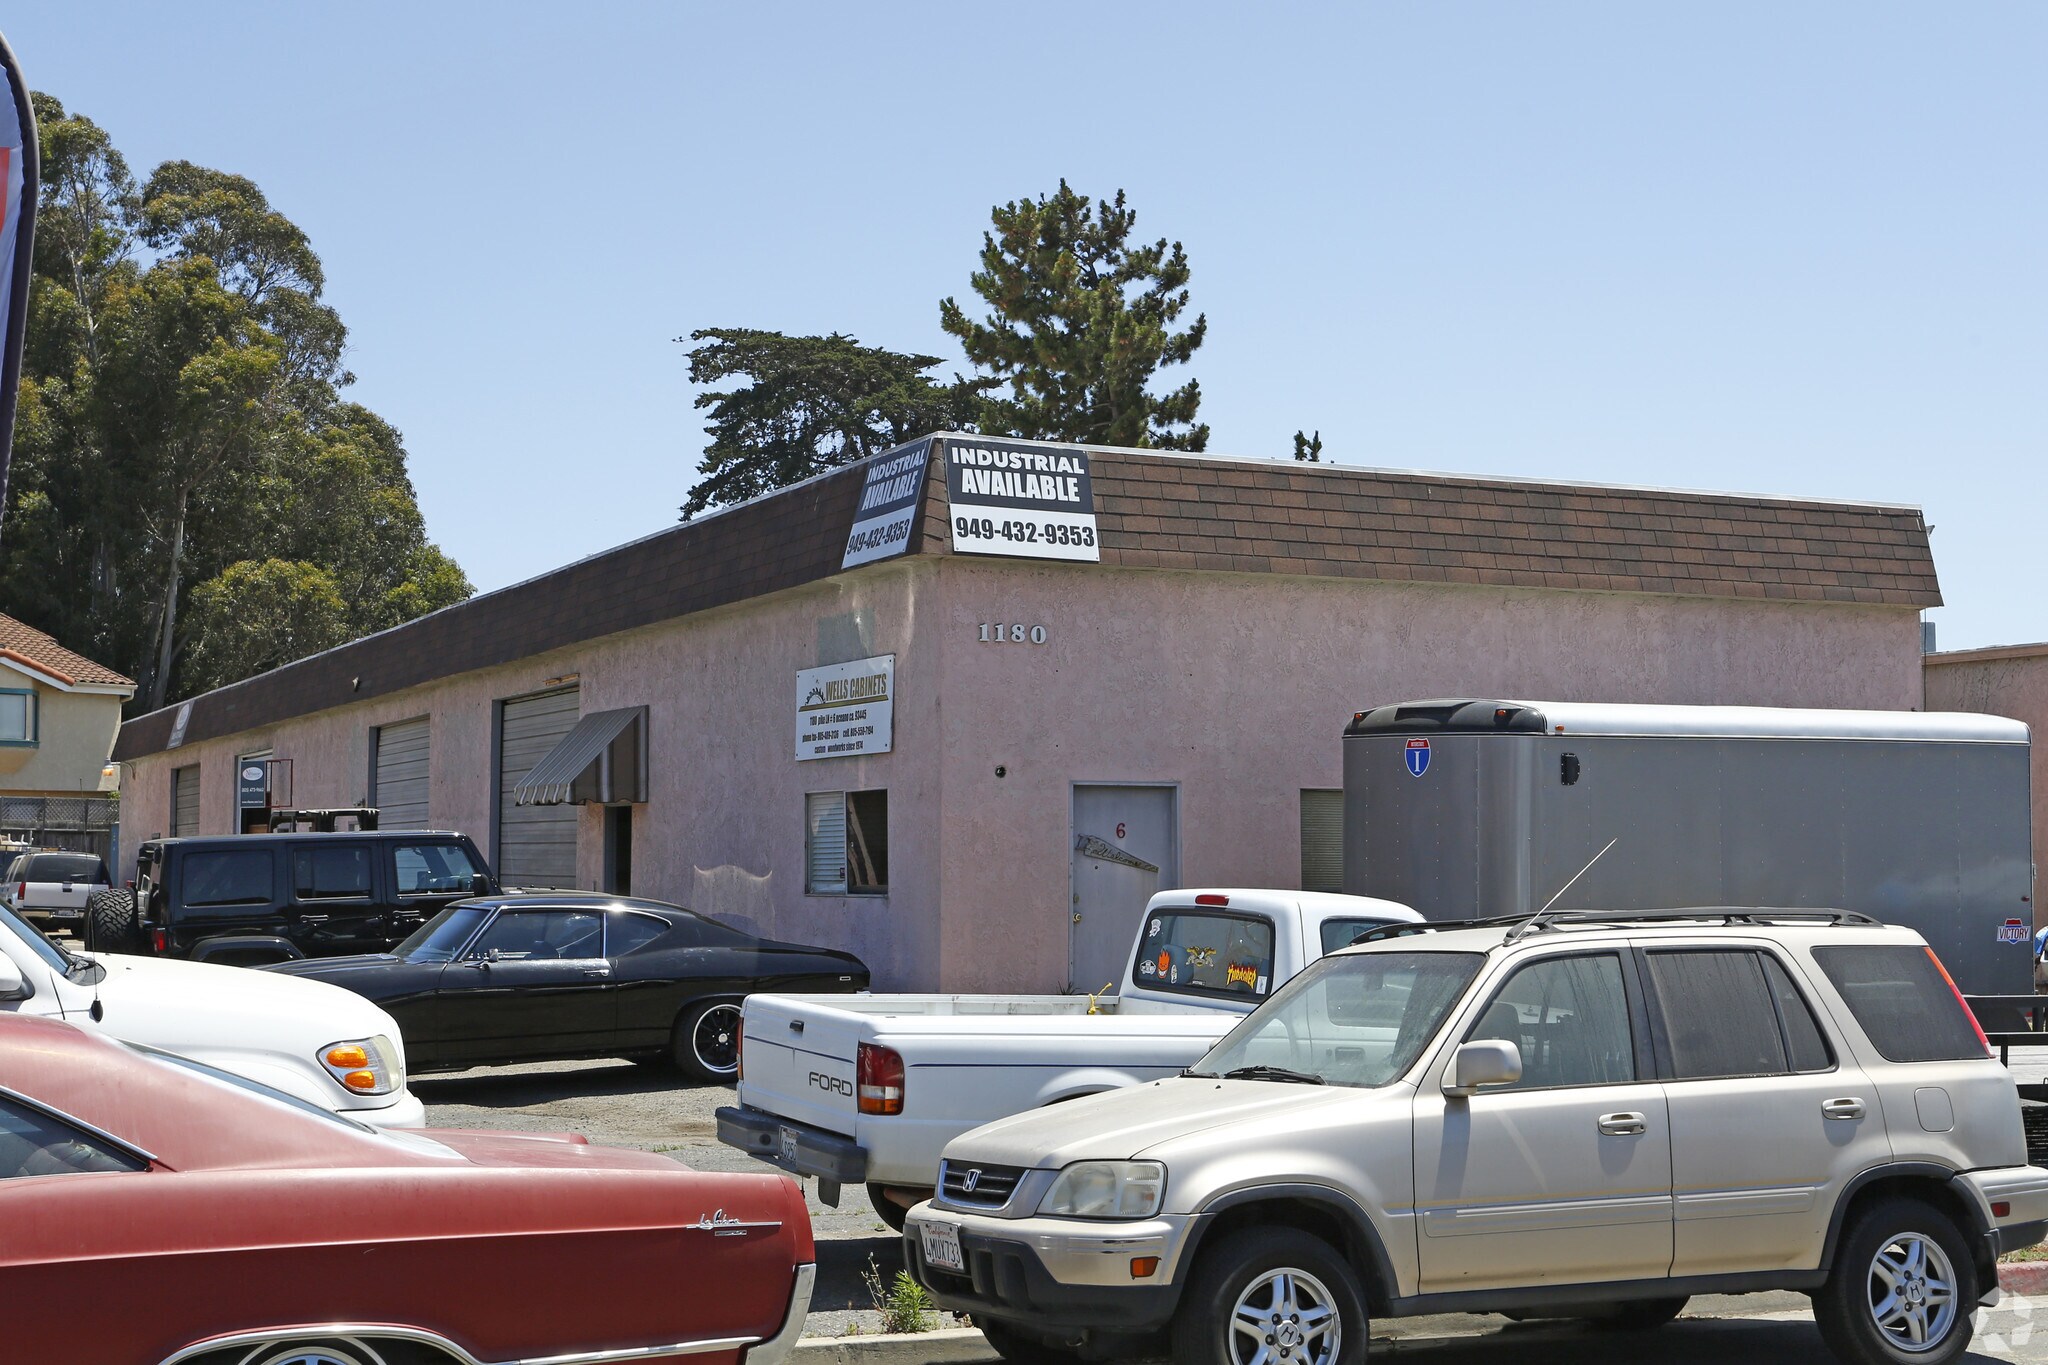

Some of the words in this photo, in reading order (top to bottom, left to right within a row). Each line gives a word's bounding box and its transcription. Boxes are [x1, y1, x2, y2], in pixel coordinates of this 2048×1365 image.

[866, 448, 926, 484] INDUSTRIAL
[951, 446, 1085, 474] INDUSTRIAL
[861, 470, 918, 512] AVAILABLE
[961, 468, 1081, 502] AVAILABLE
[846, 518, 910, 555] 949-432-9353
[955, 516, 1095, 548] 949-432-9353
[978, 622, 1047, 644] 1180
[826, 678, 848, 702] WELLS
[850, 673, 887, 698] CABINETS
[1116, 822, 1126, 839] 6
[1999, 928, 2029, 940] VICTORY
[1226, 964, 1257, 990] THRASHER
[808, 1071, 853, 1098] FORD
[925, 1238, 961, 1264] 4MUX733
